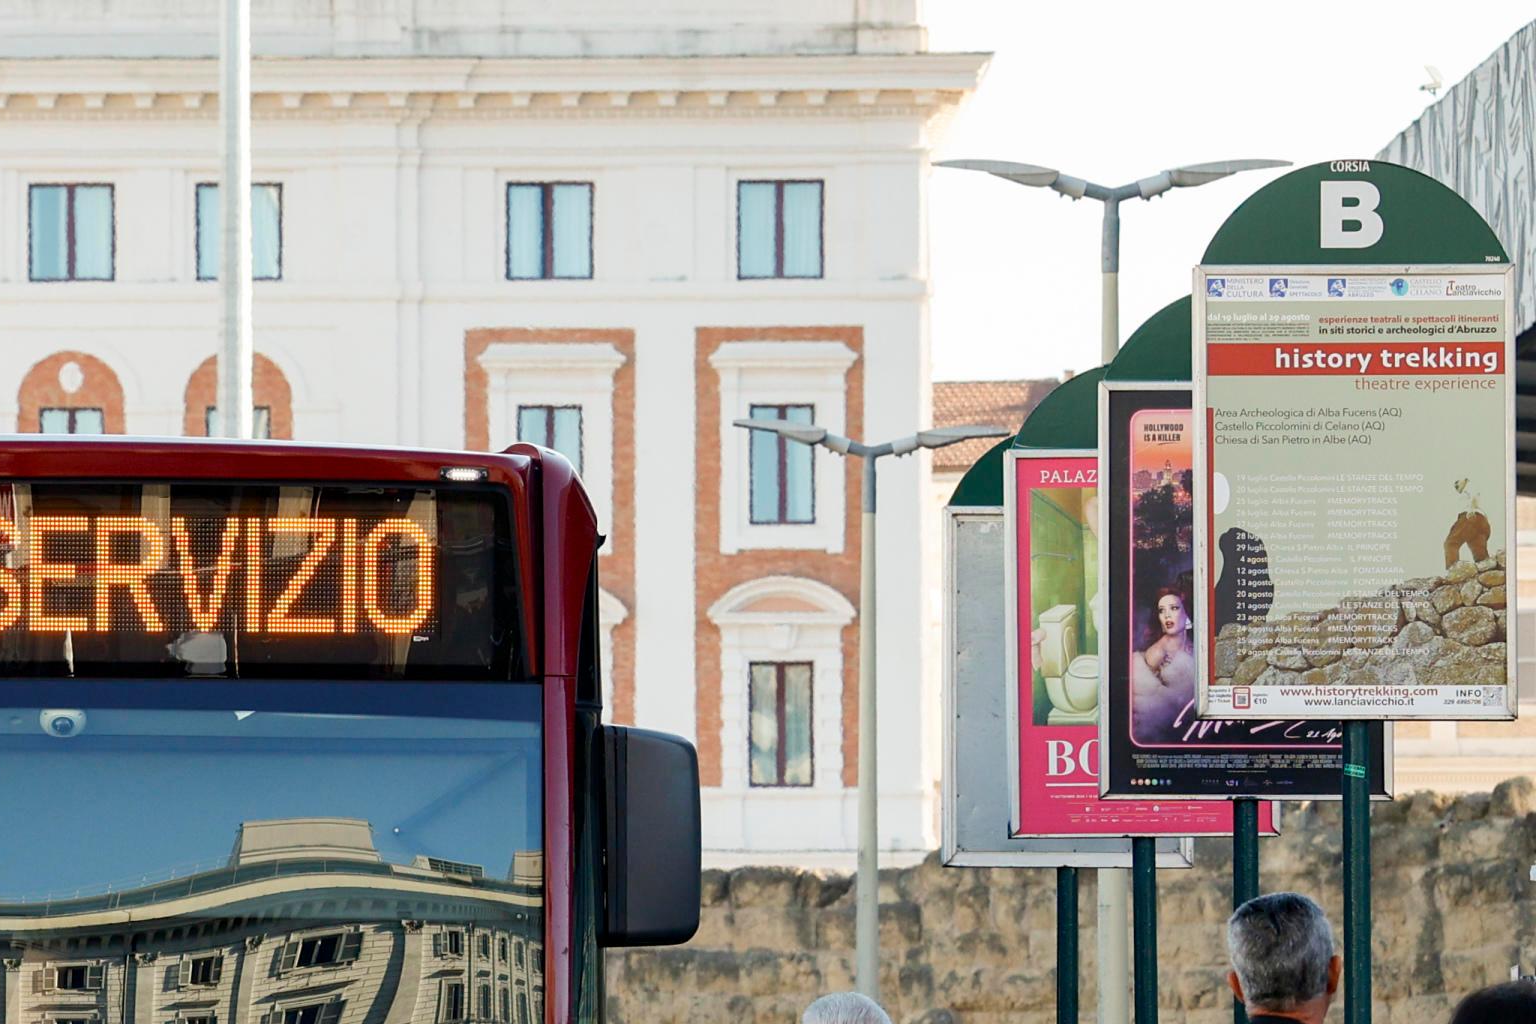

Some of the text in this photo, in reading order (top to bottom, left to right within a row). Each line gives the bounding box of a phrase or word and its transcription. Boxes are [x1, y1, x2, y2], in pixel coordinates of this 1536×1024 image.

[1330, 160, 1371, 172] CORSIA
[1320, 180, 1384, 249] B
[1445, 285, 1502, 296] Lanciavicchio
[1447, 280, 1477, 291] Teatro
[1227, 290, 1264, 298] CULTURA
[1207, 312, 1221, 321] dal
[1233, 312, 1258, 323] luglio
[1259, 312, 1267, 321] al
[1281, 313, 1311, 323] agosto
[1318, 315, 1368, 325] esperienze
[1370, 314, 1402, 324] teatrali
[1412, 314, 1456, 326] spettacoli
[1458, 313, 1499, 323] itineranti
[1318, 325, 1328, 335] in
[1330, 325, 1344, 335] siti
[1346, 325, 1376, 335] storici
[1377, 327, 1384, 335] e
[1386, 325, 1445, 337] archeologici
[1274, 346, 1498, 374] history trekking
[1355, 377, 1497, 393] theatre experience
[1215, 407, 1403, 420] Area Archeologica di Alba Fucens (AQ)
[1143, 423, 1184, 432] HOLLYWOOD
[1215, 421, 1385, 432] Castello Piccolomini di Celano (AQ)
[1143, 433, 1181, 442] IS A KILLER
[1215, 434, 1372, 446] Chiesa di San Pietro in Albe (AQ)
[1039, 470, 1098, 484] PALAZ
[1236, 532, 1246, 540] 28
[1236, 544, 1246, 552] 29
[1240, 556, 1246, 564] 4
[1236, 568, 1246, 576] 12
[1236, 579, 1246, 587] 13
[1247, 580, 1273, 588] agosto
[1236, 590, 1246, 598] 20
[1247, 591, 1273, 600] agosto
[1236, 602, 1246, 610] 21
[1247, 602, 1273, 612] agosto
[1353, 602, 1383, 610] STANZE
[1385, 602, 1400, 610] DEL
[1401, 602, 1430, 610] TEMPO
[1236, 614, 1246, 622] 23
[1327, 614, 1398, 622] #MEMORYTRACKS
[1327, 625, 1398, 633] #MEMORYTRACKS
[1327, 637, 1398, 645] #MEMORYTRACKS
[1280, 686, 1438, 698] www.historytrekking.com
[1455, 689, 1482, 698] INFO
[1253, 697, 1268, 705] €10
[1304, 697, 1415, 707] www.lanciavicchio.it
